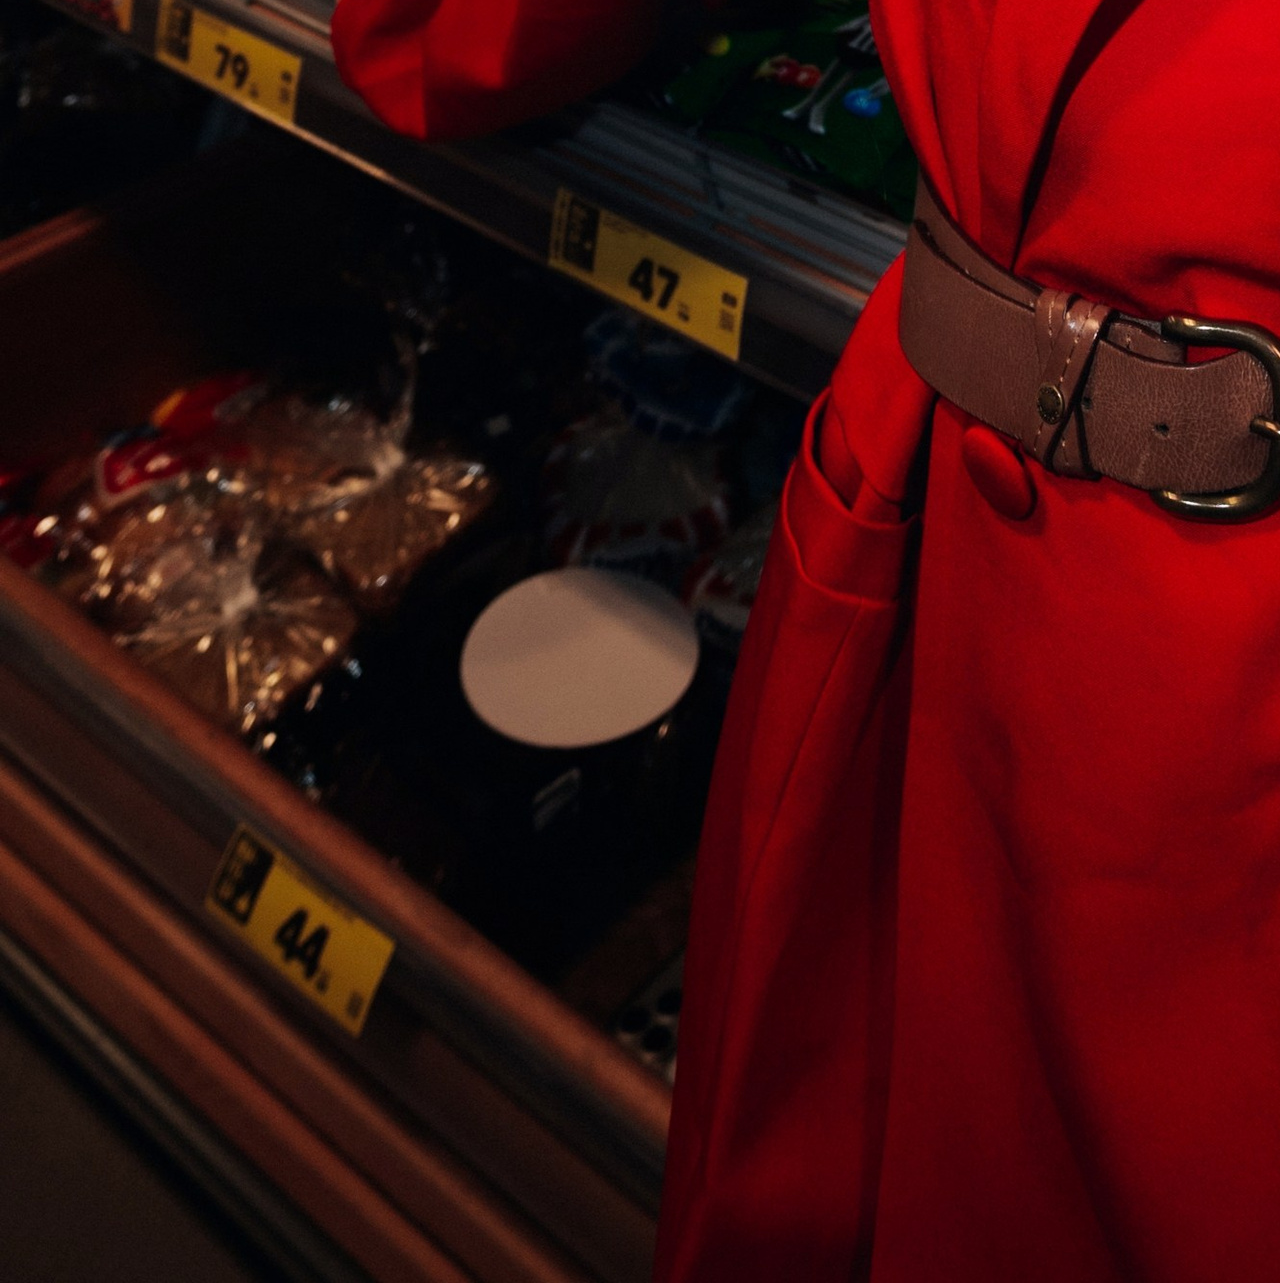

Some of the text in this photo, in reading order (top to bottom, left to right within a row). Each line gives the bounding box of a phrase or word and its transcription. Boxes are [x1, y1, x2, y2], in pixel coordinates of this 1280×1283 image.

[214, 43, 251, 90] 79
[627, 256, 681, 312] 47
[273, 908, 331, 981] 44
